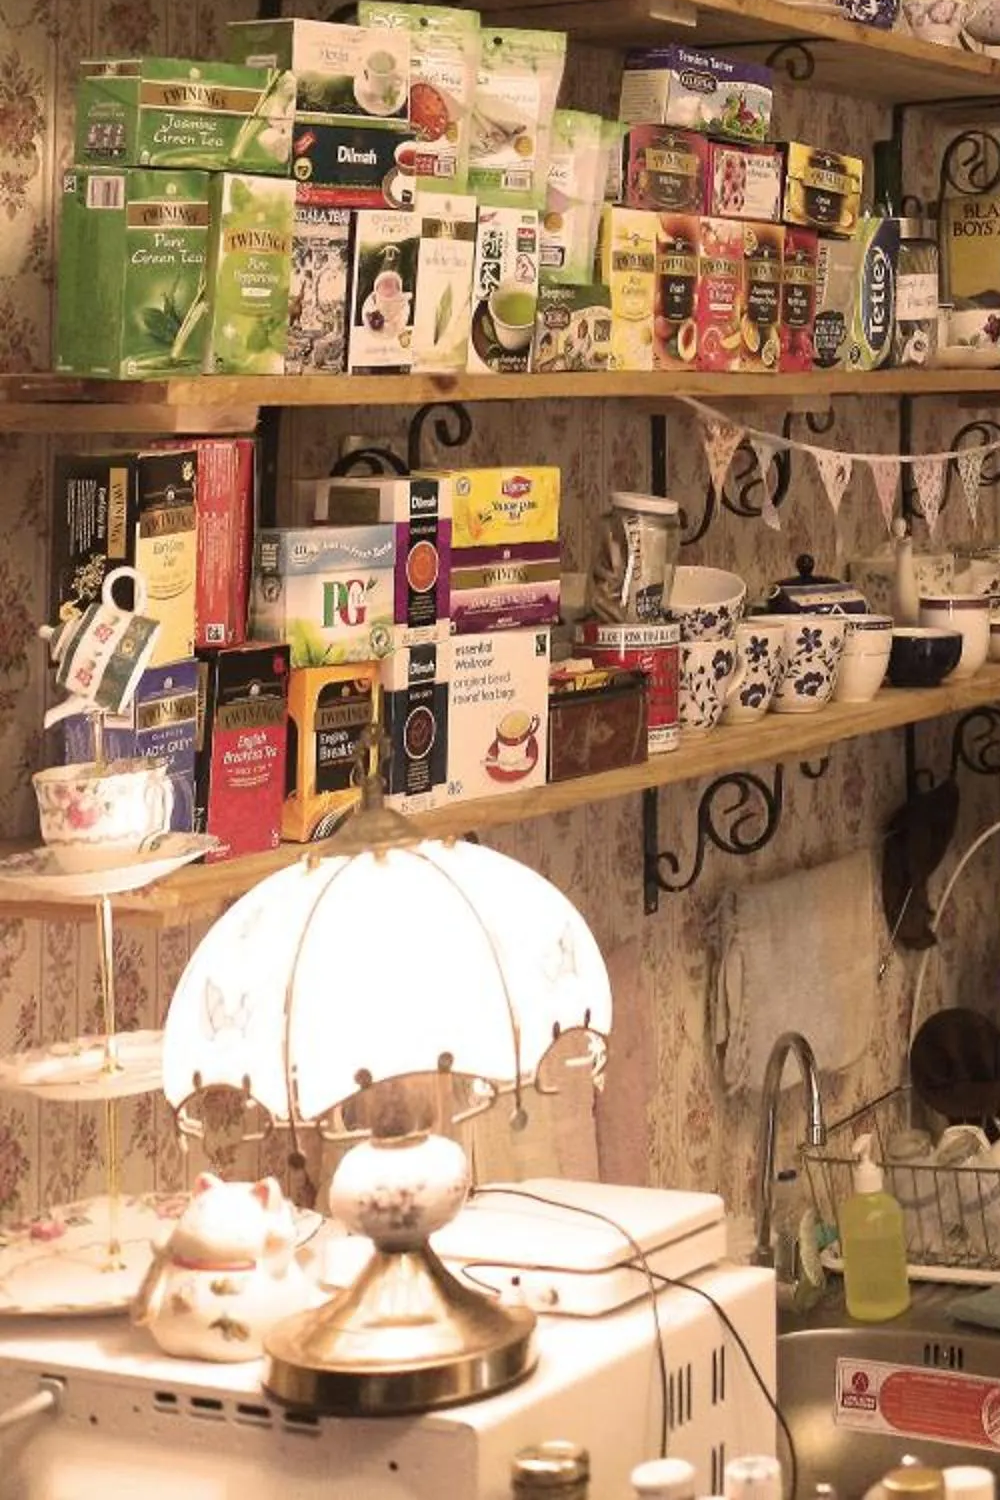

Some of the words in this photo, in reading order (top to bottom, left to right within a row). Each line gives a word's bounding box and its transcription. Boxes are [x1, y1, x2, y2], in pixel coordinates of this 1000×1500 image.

[336, 145, 378, 166] Dilmah
[866, 248, 894, 336] Tetley
[323, 579, 367, 629] PG
